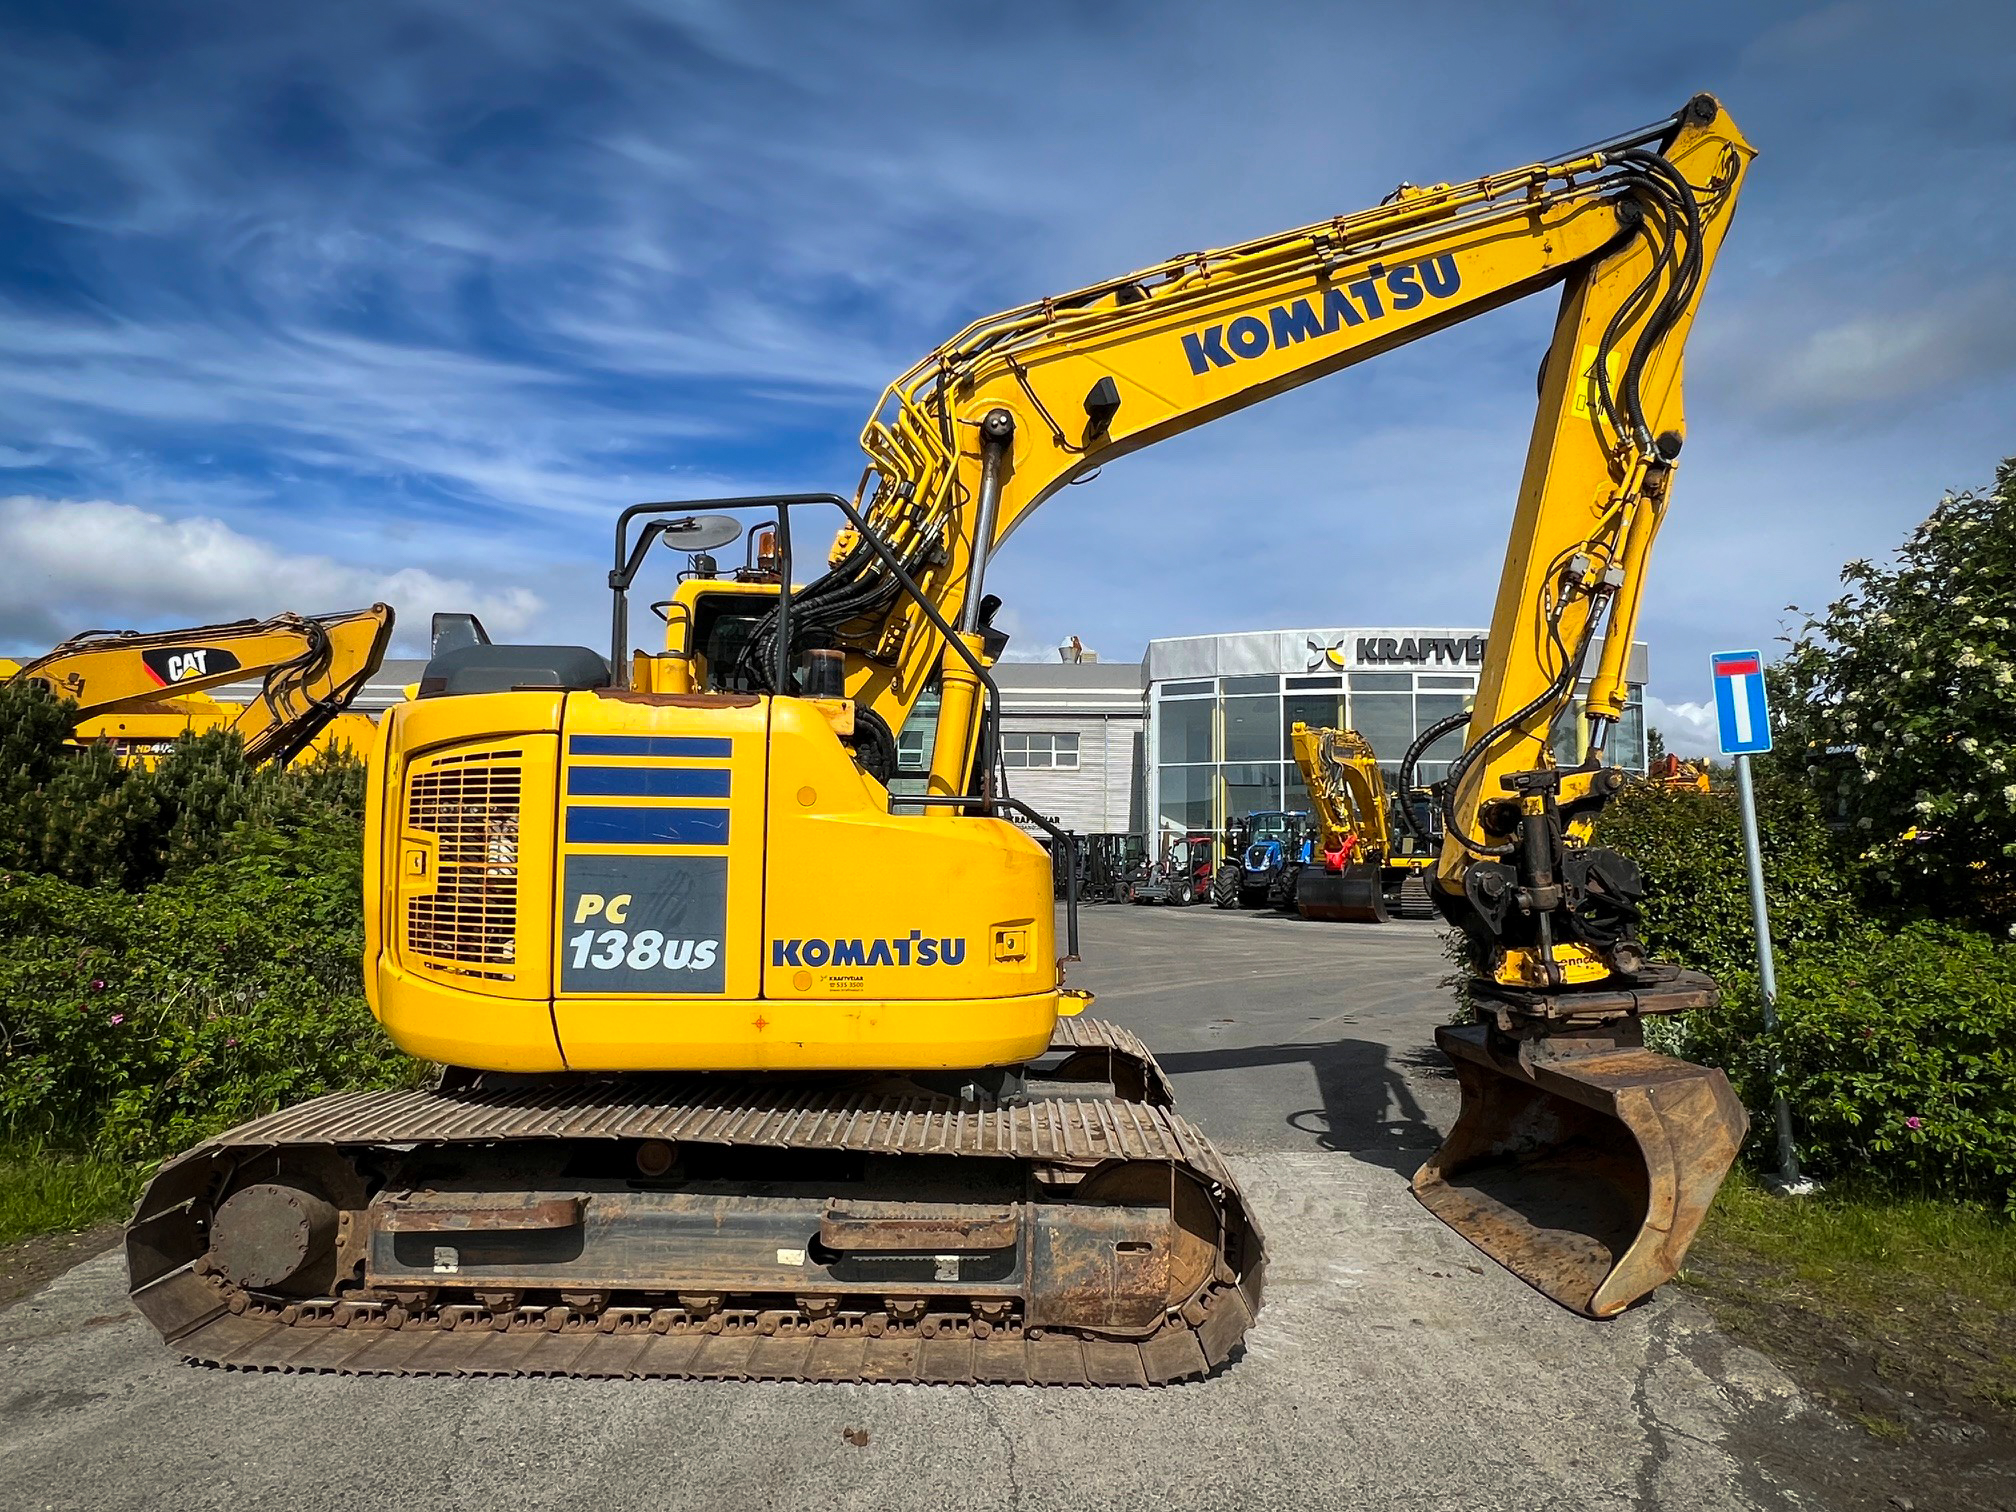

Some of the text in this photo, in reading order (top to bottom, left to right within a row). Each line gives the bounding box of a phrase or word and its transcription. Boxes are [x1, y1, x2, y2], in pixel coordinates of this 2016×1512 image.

[1180, 253, 1461, 376] KOMATSU
[1356, 635, 1488, 661] KRAFTVÉ
[168, 650, 207, 682] CAT
[573, 894, 632, 925] PC
[772, 929, 966, 968] KOMATSU
